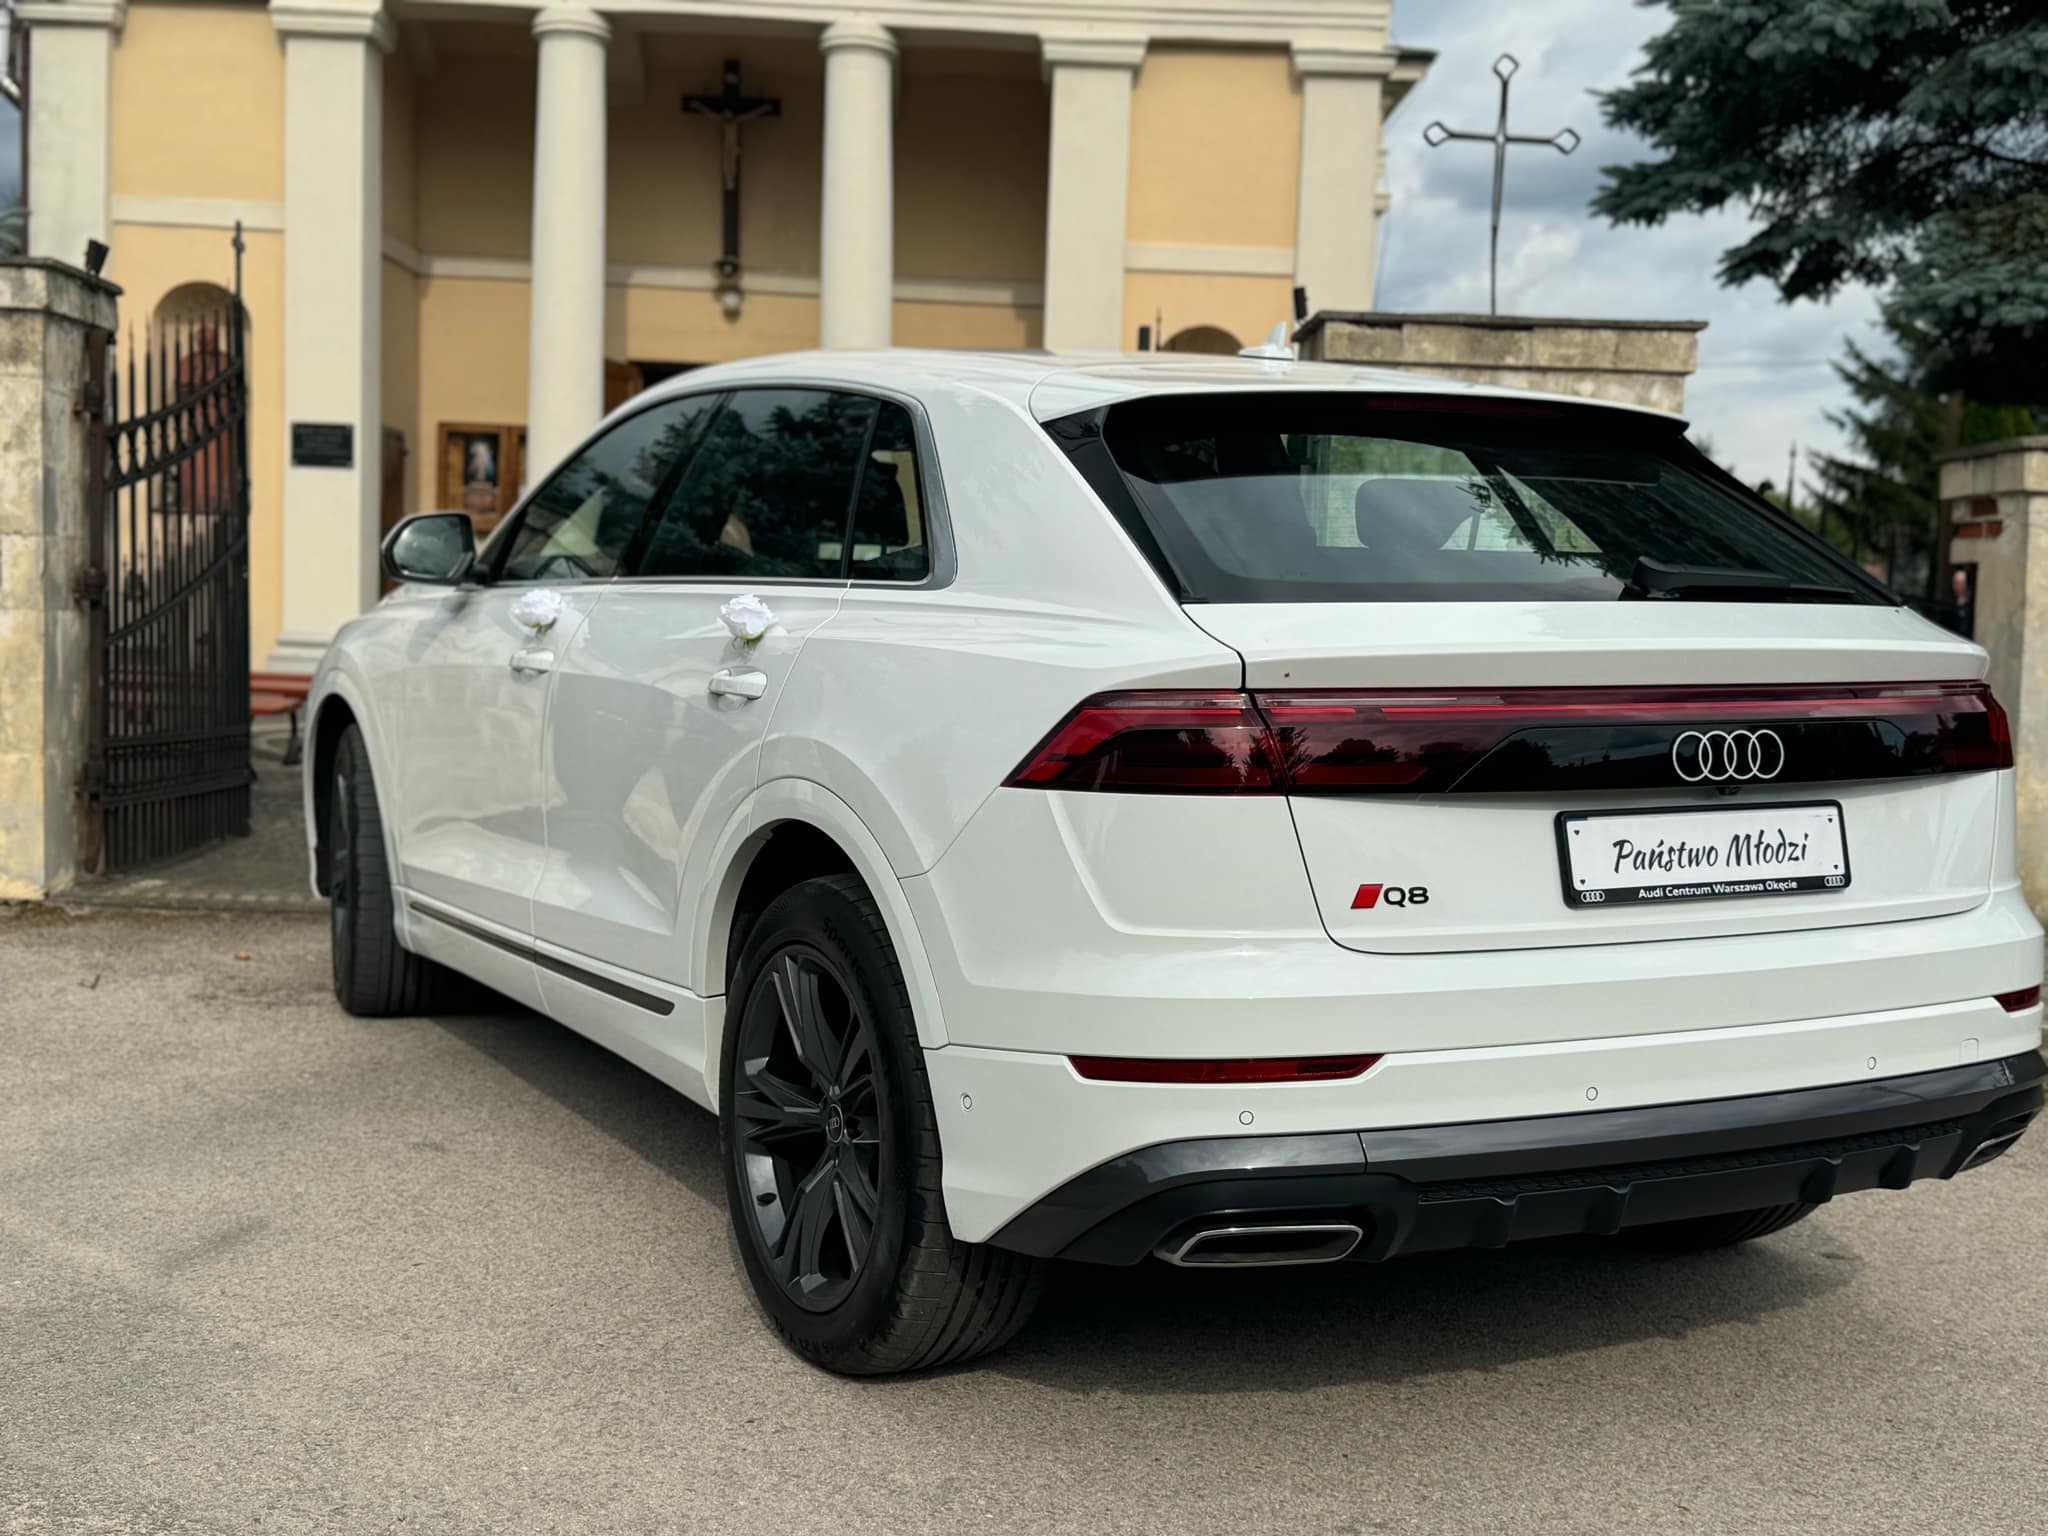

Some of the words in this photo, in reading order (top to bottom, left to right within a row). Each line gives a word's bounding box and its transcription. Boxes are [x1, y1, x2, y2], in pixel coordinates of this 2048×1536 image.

[1612, 839, 1719, 874] Państwo
[1726, 828, 1809, 867] Młodzi
[1383, 886, 1430, 908] Q8
[1638, 888, 1664, 899] Audi
[1665, 886, 1712, 897] Centrum
[1712, 882, 1764, 894] Warszawa
[1765, 879, 1798, 891] Okęcie
